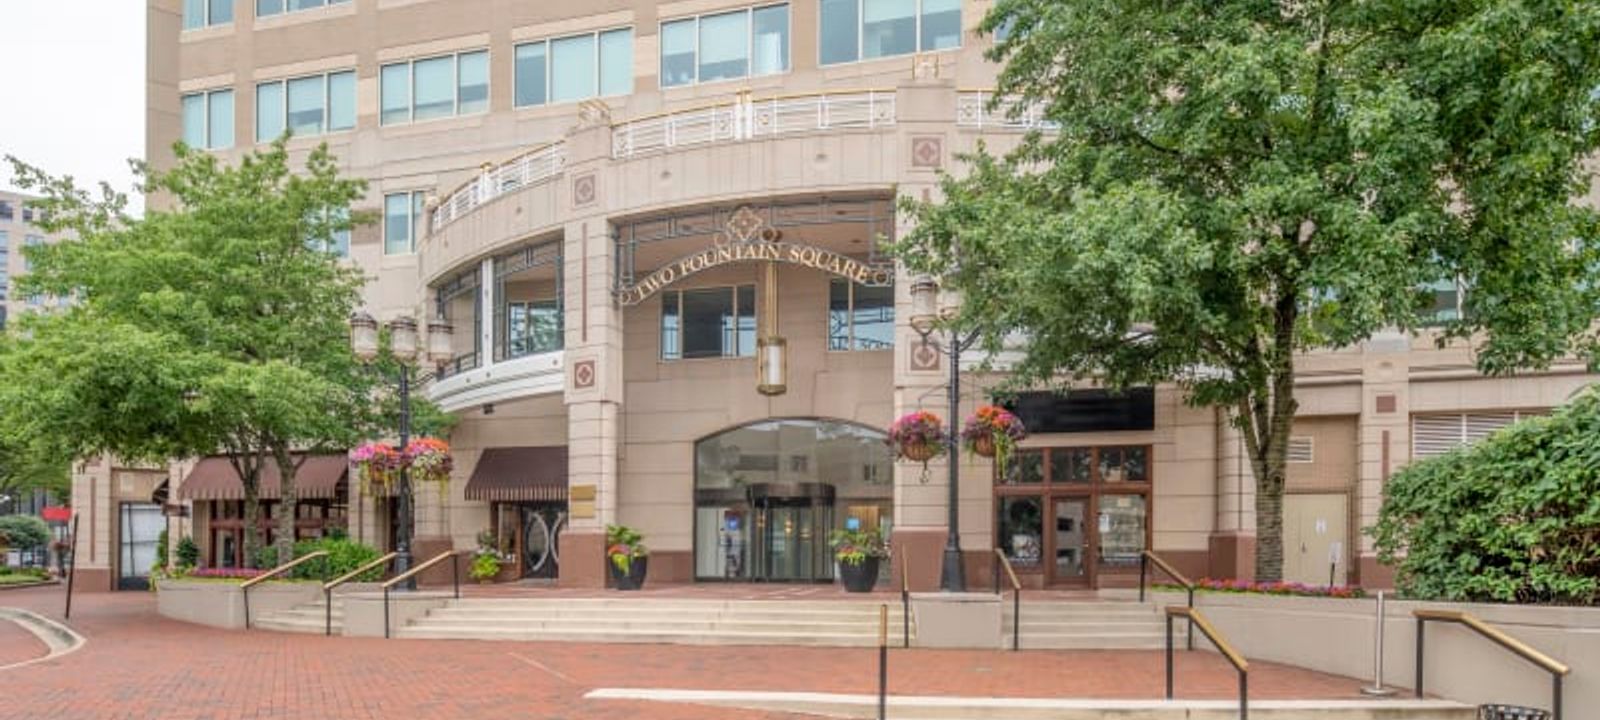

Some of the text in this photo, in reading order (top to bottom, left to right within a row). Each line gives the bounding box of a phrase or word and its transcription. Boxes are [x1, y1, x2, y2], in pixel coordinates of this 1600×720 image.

[635, 243, 868, 300] TWO FOUNTAIN SQUARE
